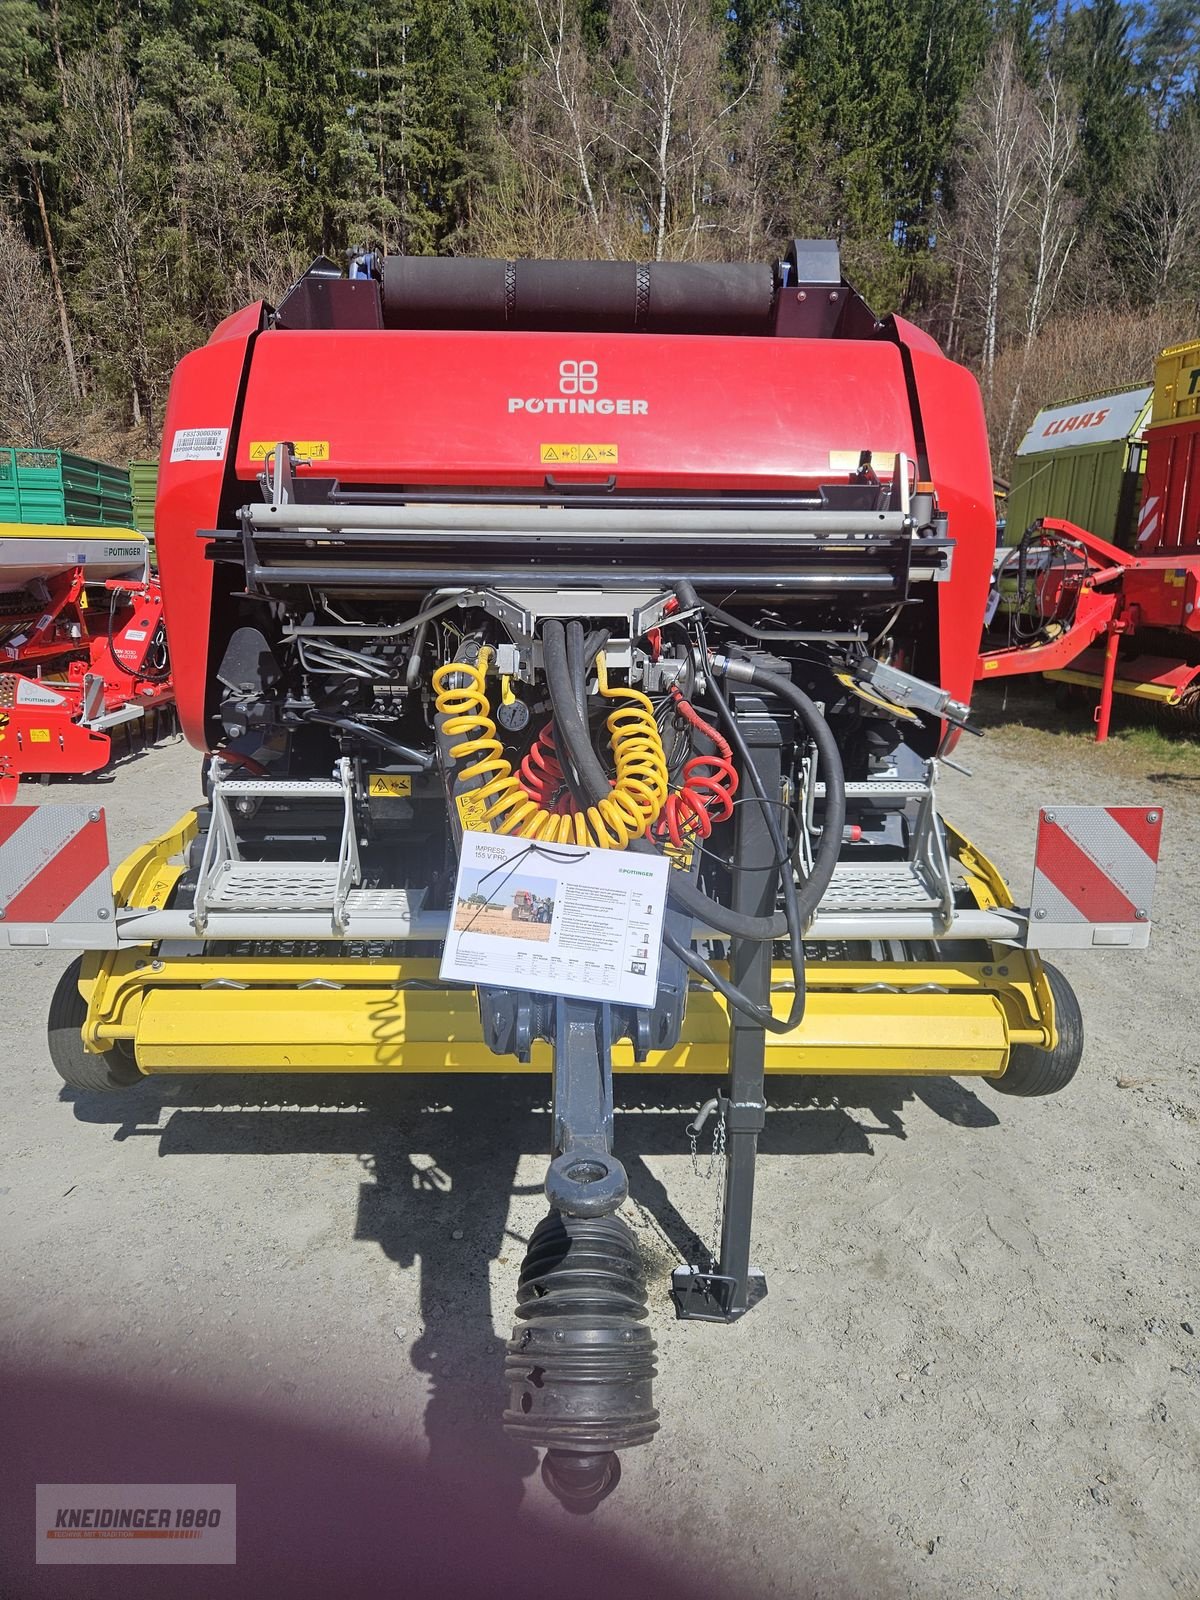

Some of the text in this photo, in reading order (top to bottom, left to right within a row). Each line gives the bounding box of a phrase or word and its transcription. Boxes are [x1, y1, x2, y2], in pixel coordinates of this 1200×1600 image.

[508, 398, 649, 415] PÖTTINGER
[1042, 408, 1110, 437] CLAAS
[475, 845, 506, 855] IMPRESS
